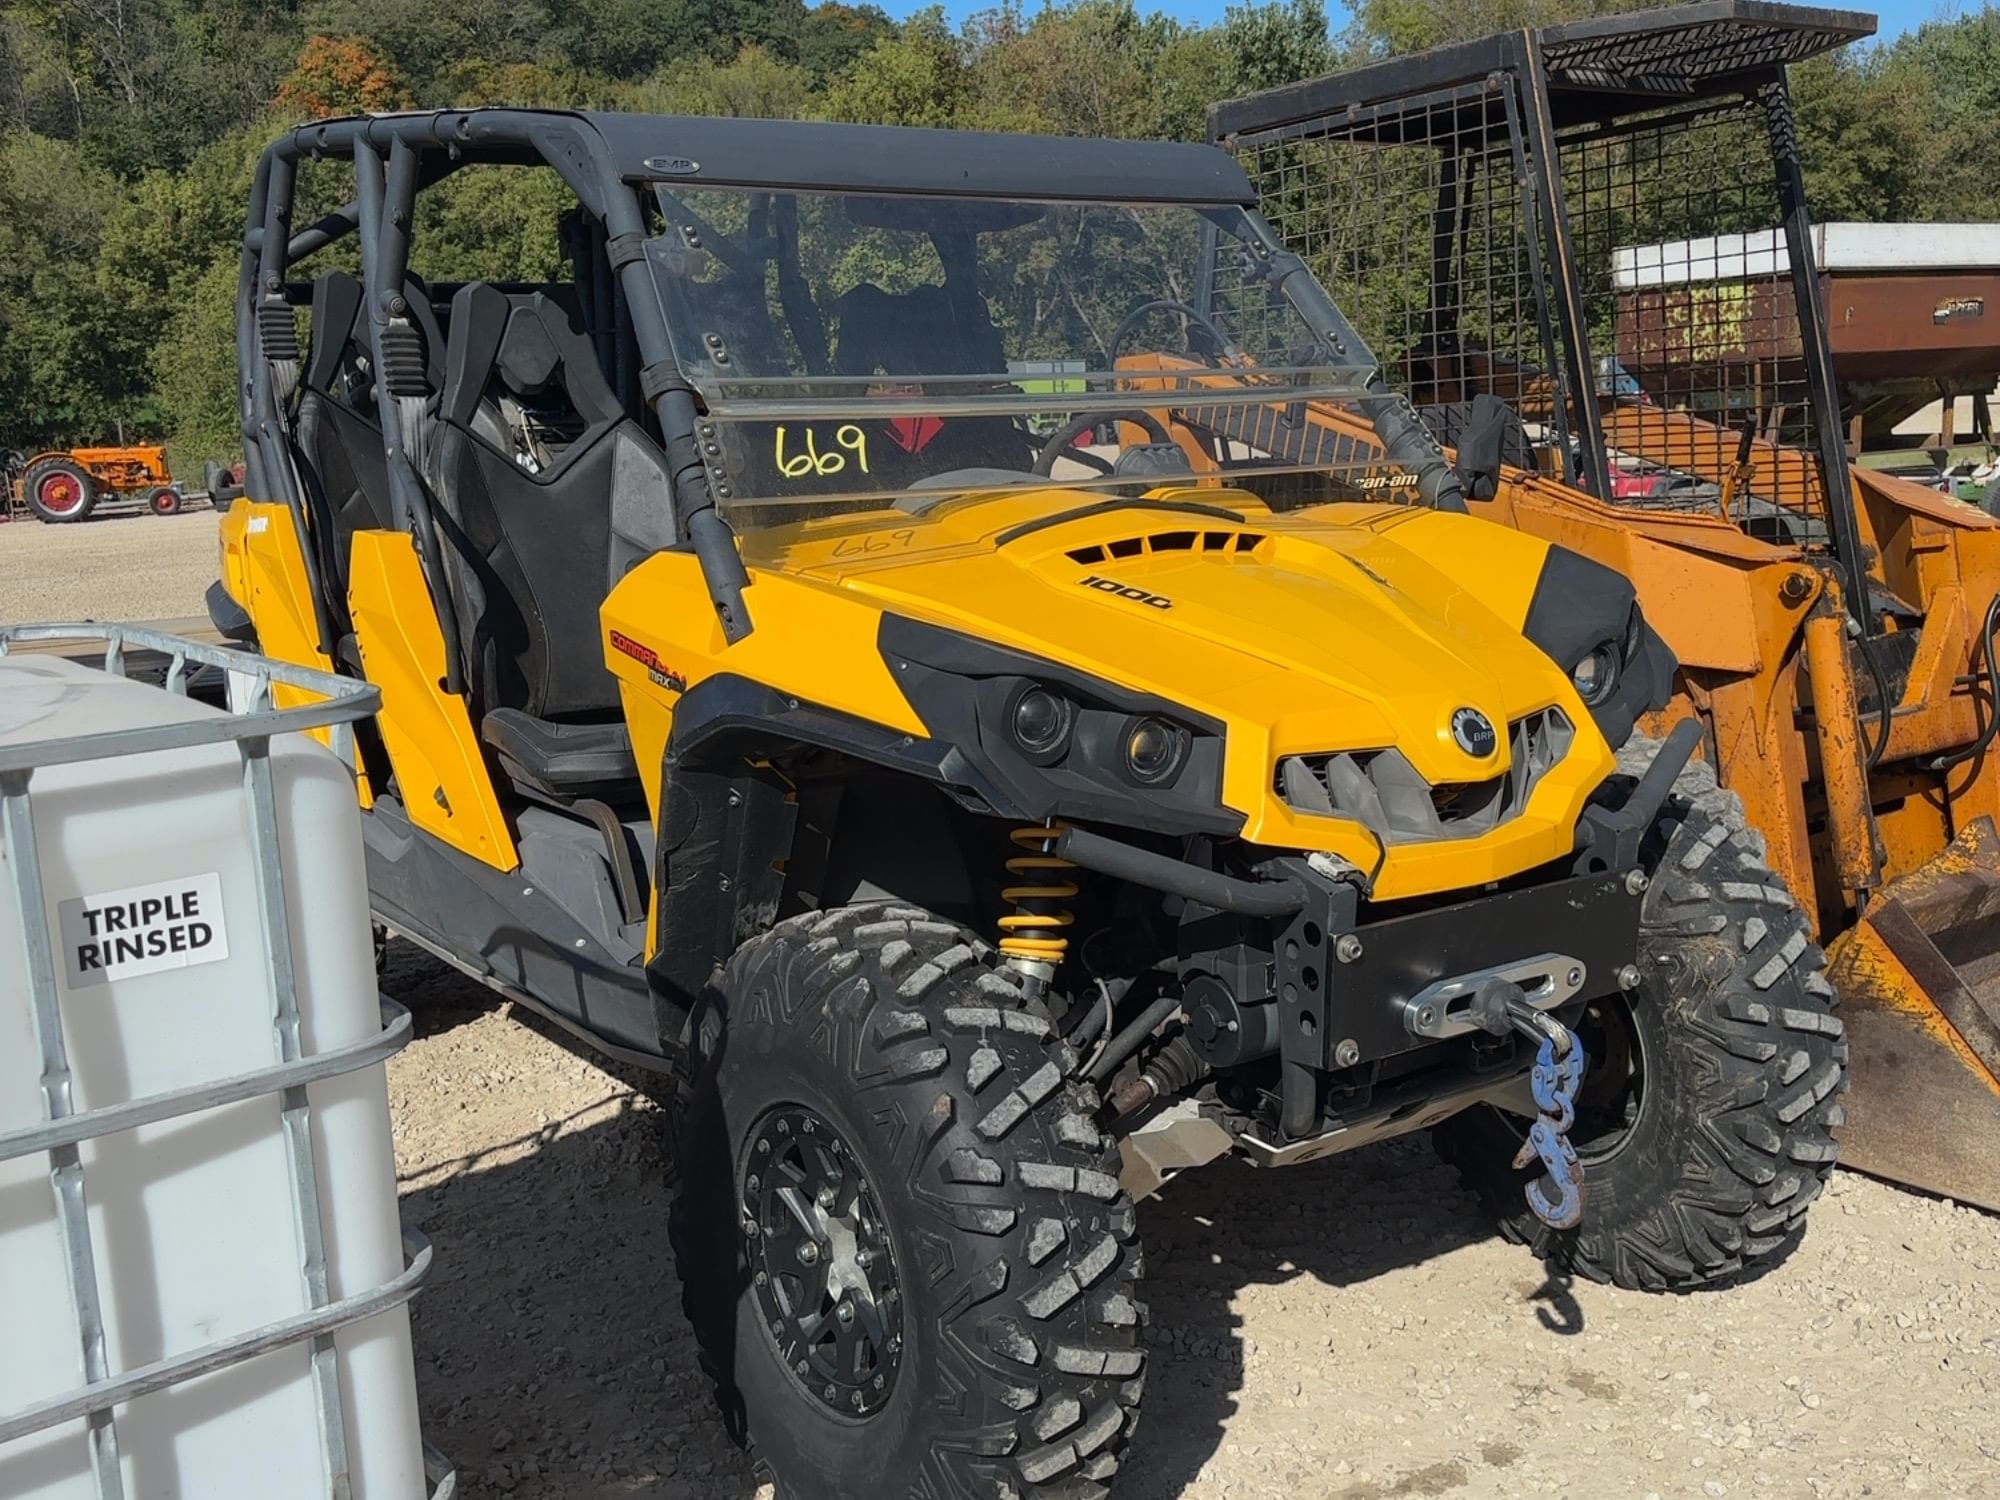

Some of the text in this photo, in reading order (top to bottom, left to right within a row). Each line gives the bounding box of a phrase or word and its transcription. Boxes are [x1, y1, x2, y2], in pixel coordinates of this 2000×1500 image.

[653, 159, 690, 169] EMP
[775, 424, 869, 478] 669
[1079, 576, 1173, 609] 1000
[1473, 731, 1494, 742] BRP
[82, 890, 200, 937] TRIPLE
[77, 922, 213, 972] RINSED
